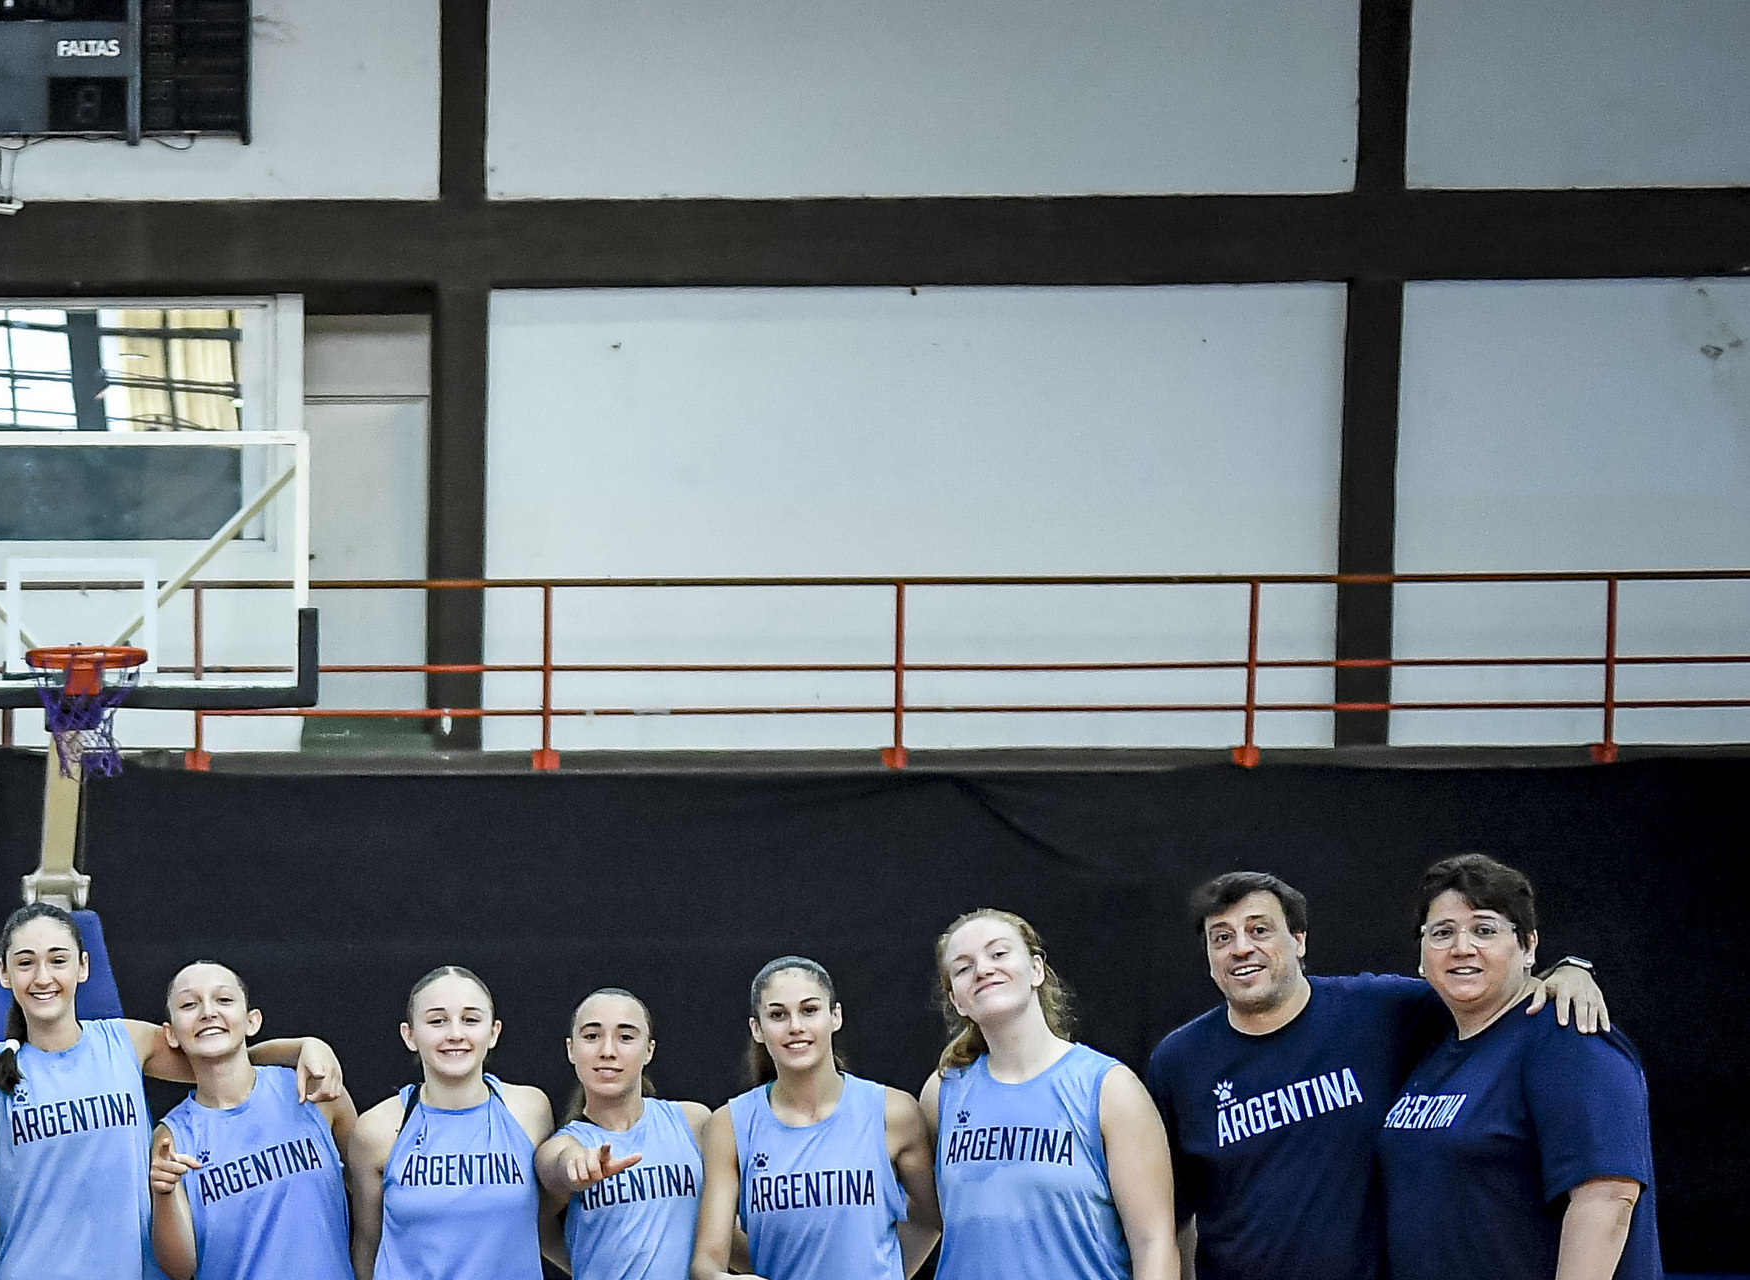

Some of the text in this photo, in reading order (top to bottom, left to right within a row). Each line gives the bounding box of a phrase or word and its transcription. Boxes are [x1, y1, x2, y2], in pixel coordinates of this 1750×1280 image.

[56, 40, 120, 57] FALTAS
[12, 1092, 138, 1146] ARGENTINA
[1218, 1066, 1362, 1147] ARGENTINA
[946, 1126, 1073, 1167] ARGENTINA
[200, 1138, 323, 1206] ARGENTINA
[400, 1152, 525, 1187] ARGENTINA
[752, 1169, 876, 1213] ARGENTINA
